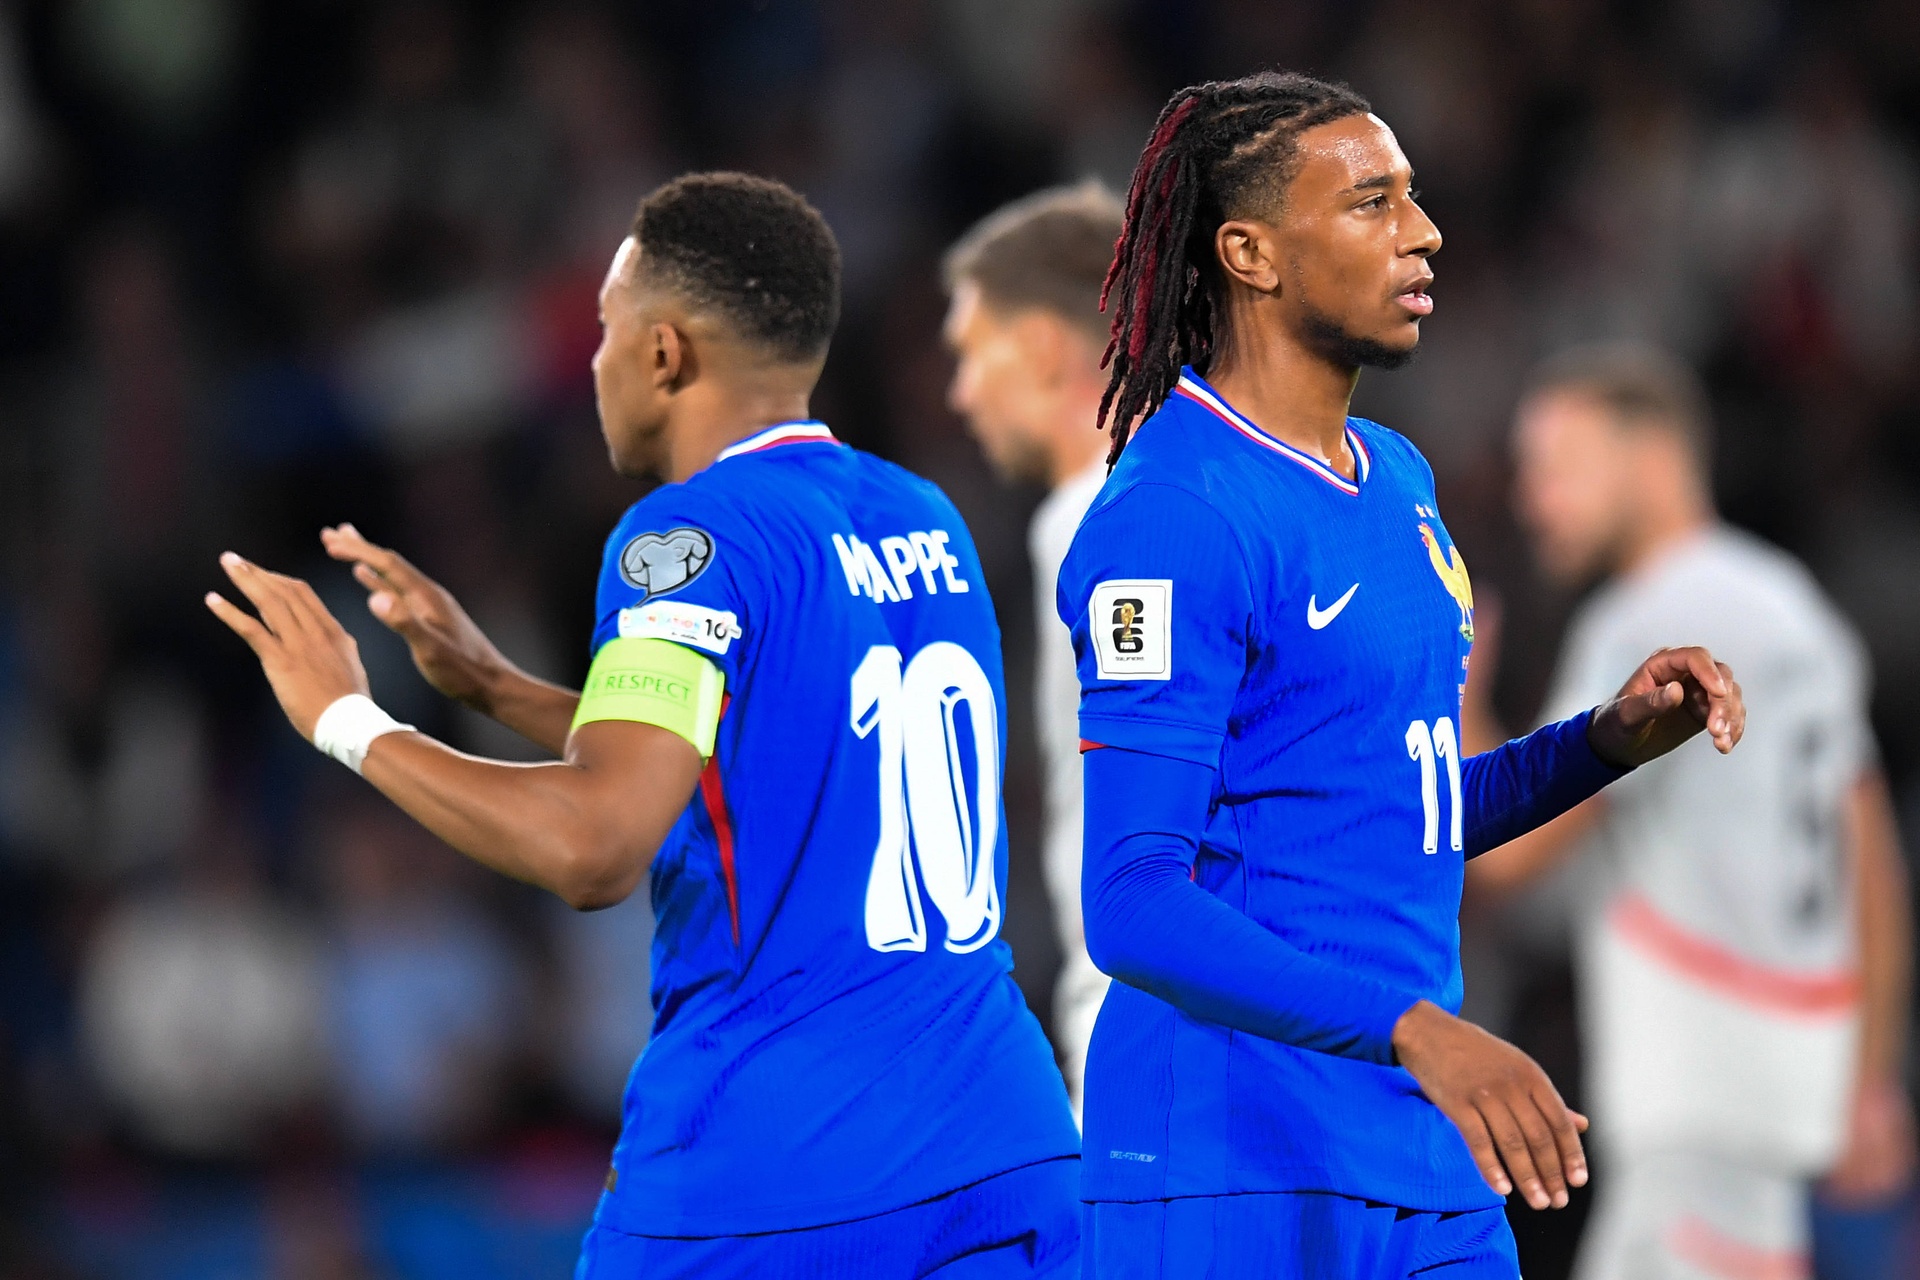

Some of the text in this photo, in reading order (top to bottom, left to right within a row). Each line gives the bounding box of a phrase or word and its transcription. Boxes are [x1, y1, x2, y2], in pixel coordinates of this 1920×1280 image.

[605, 674, 692, 702] RESPECT
[851, 641, 1000, 954] 10
[1405, 716, 1464, 855] 11
